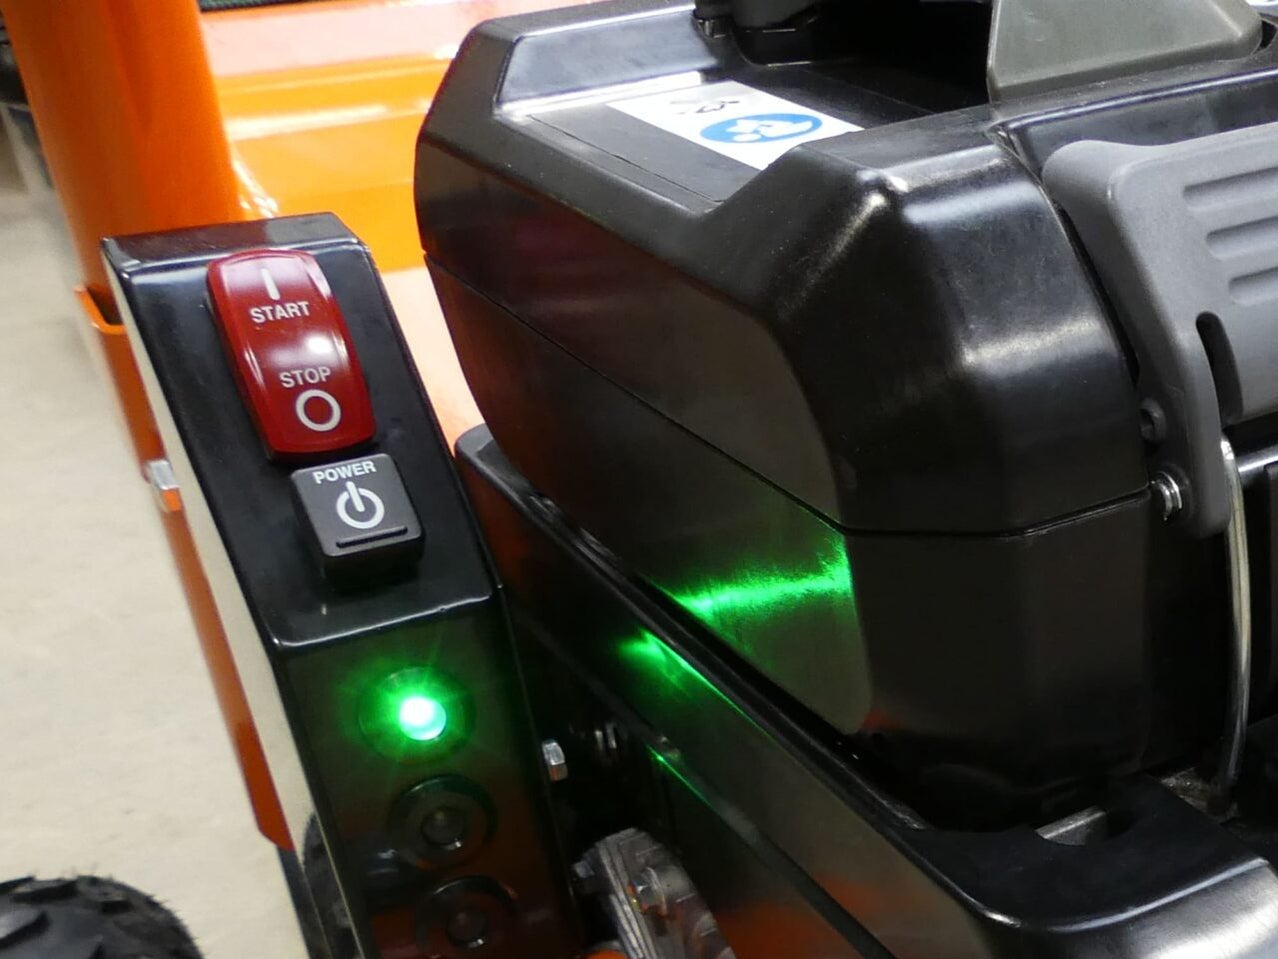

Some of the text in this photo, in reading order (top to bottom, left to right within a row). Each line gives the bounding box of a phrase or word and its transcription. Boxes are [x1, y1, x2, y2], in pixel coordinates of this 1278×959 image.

[250, 301, 310, 324] START
[279, 365, 332, 389] STOP
[313, 460, 377, 485] POWER
